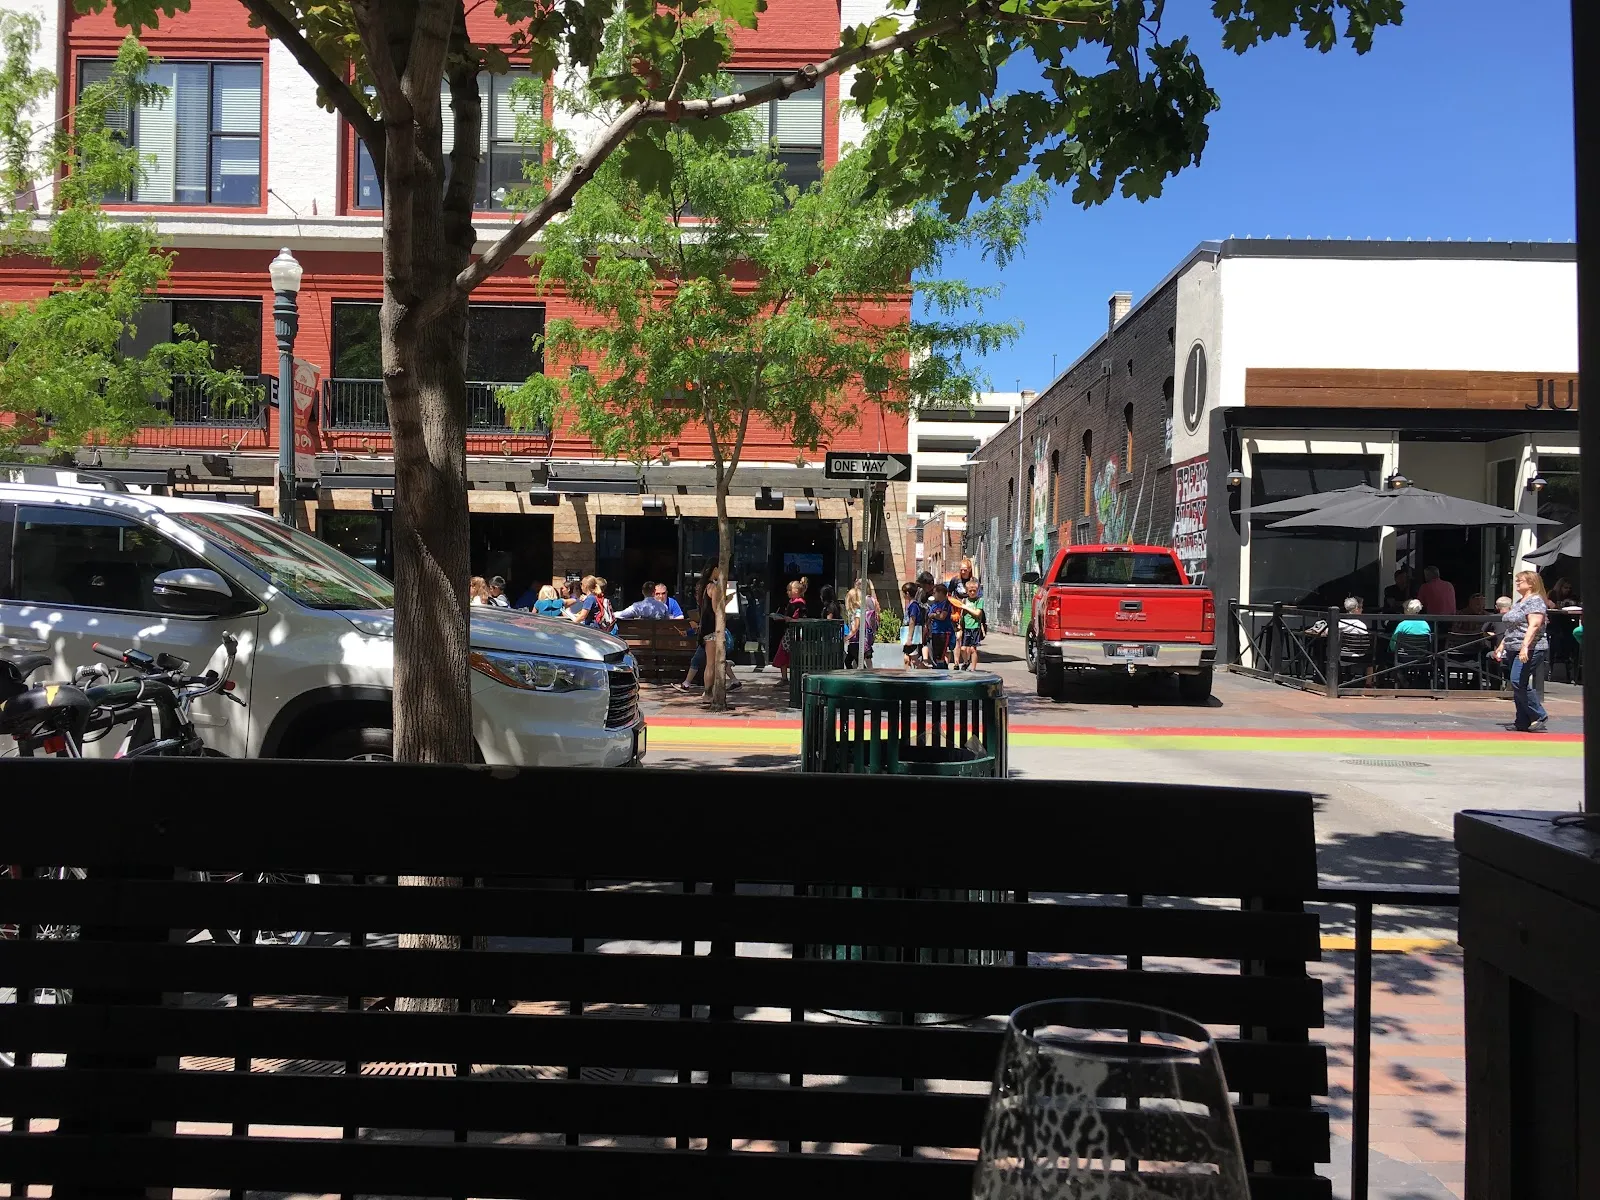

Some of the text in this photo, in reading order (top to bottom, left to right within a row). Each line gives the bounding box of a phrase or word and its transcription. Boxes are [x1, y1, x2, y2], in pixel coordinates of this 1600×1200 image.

[1189, 348, 1201, 424] J
[1525, 379, 1574, 411] JU
[834, 460, 886, 472] ONE WAY
